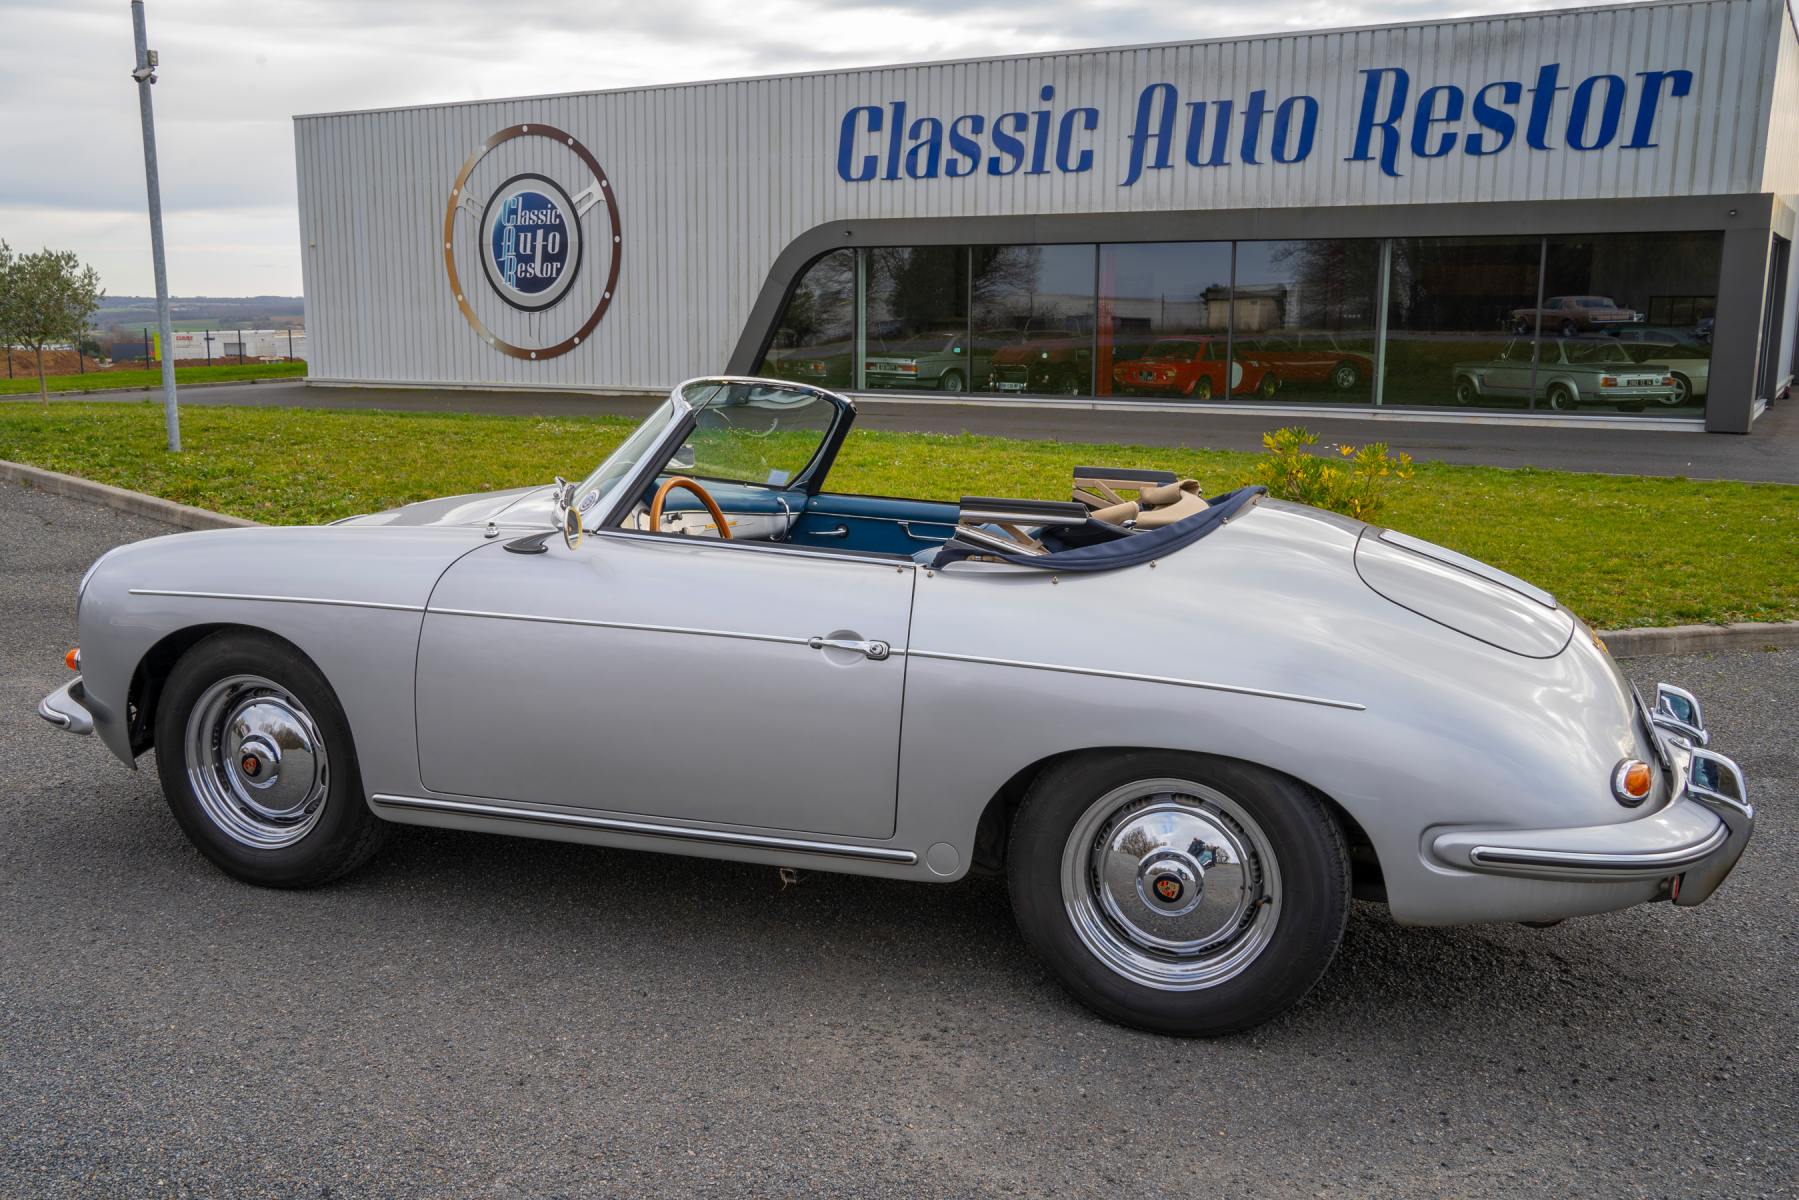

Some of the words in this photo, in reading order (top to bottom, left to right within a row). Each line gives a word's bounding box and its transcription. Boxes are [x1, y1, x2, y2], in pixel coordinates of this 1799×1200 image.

[837, 85, 1099, 182] Classic
[1117, 83, 1319, 186] Auto
[1343, 63, 1693, 177] Restor
[502, 196, 560, 226] Classic
[498, 227, 560, 261] Auto
[503, 255, 560, 290] Restor
